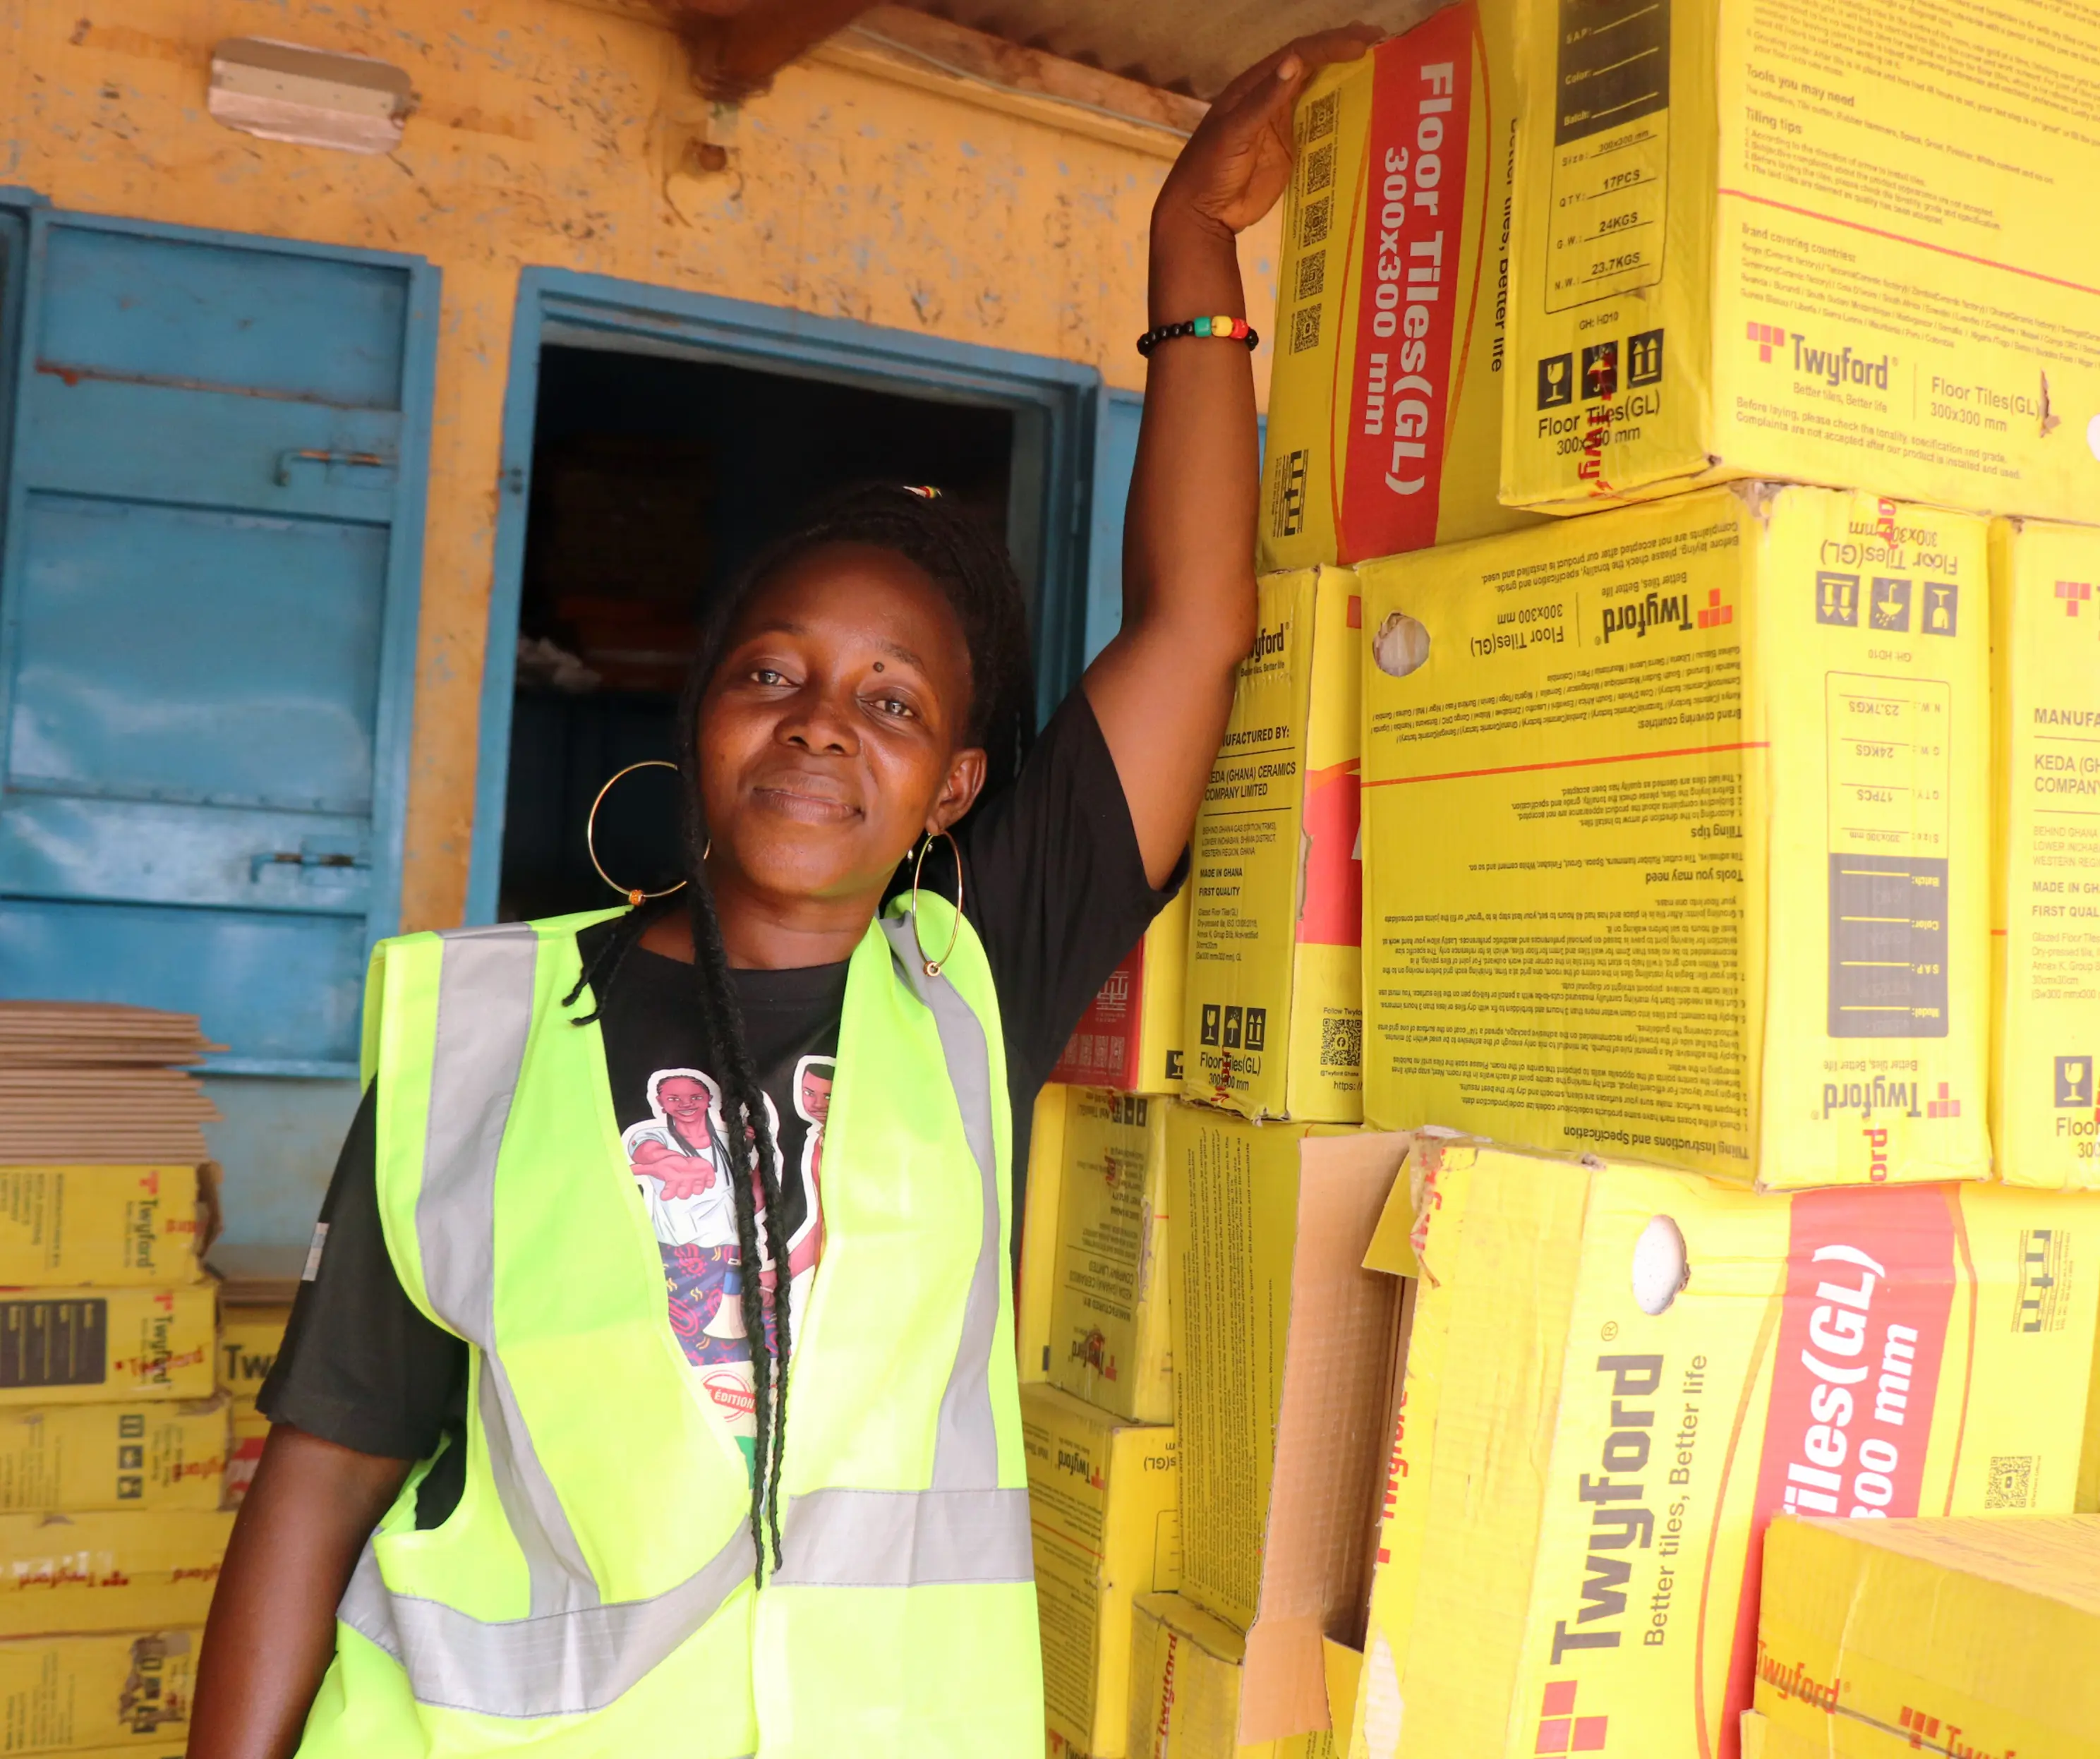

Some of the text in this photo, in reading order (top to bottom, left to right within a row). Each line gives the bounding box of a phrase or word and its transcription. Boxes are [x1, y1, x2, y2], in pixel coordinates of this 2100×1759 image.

[1564, 67, 1591, 86] Color:
[1745, 63, 1854, 107] Tools you may need
[1780, 116, 1802, 137] tips
[1603, 167, 1640, 192] 17PCS
[1598, 210, 1638, 234] 24KGS
[1591, 250, 1640, 276] 23.7KGS
[1385, 61, 1454, 495] Floor Tiles(GL)
[1364, 146, 1408, 436] 300x300 mm
[1579, 309, 1619, 331] GH: HD10
[1790, 332, 1888, 390] Twyford
[1793, 382, 1821, 397] Better
[1846, 393, 1871, 409] Better
[1874, 399, 1888, 413] life
[1931, 376, 2040, 421] Floor Tiles(GL)
[1538, 387, 1661, 439] Floor Tiles(GL)
[1931, 402, 2007, 432] 300x300 mm
[1614, 425, 1641, 445] mm
[1849, 521, 1878, 538] mm
[1481, 520, 1737, 586] Complaints are not accepted after our product is installed and used.
[1709, 536, 1739, 550] Before
[1625, 555, 1648, 567] check
[1651, 548, 1676, 562] please
[1819, 538, 1957, 576] Floor Tiles(GL)
[1580, 561, 1610, 576] tonality,
[1612, 559, 1624, 572] the
[1494, 581, 1516, 593] grade.
[1519, 578, 1531, 590] and
[1533, 569, 1579, 587] specification
[1601, 571, 1686, 599] Better tiles, Better life
[1497, 603, 1564, 625] 300x300 mm
[1603, 593, 1694, 643] Twyford
[1248, 623, 1284, 663] yford
[1470, 626, 1564, 658] Floor Tiles(GL)
[1867, 648, 1911, 663] GH: HD10
[1848, 699, 1899, 716] 23.7KGS
[1637, 708, 1741, 730] Brand covering countries:
[1276, 725, 1289, 739] BY:
[1855, 743, 1894, 758] 24KGS
[1209, 761, 1296, 785] EDA (GHANA) CERAMICS
[2034, 754, 2075, 773] KEDA
[1205, 783, 1267, 801] COMPANY LIMITED
[1856, 788, 1893, 803] 17PCS
[1690, 821, 1742, 840] Tiling tips
[1849, 831, 1864, 841] mm
[1866, 831, 1900, 843] 300x300
[1200, 867, 1243, 878] MADE IN GHANA
[1645, 866, 1743, 885] Tools you may need
[1199, 887, 1240, 896] FIRST QUALITY
[2032, 881, 2065, 893] MADE
[2068, 882, 2080, 894] IN
[2032, 905, 2065, 917] FIRST
[1910, 918, 1939, 931] Color:
[1200, 1052, 1222, 1069] Floor
[1823, 1057, 1917, 1072] Better tiles, Better life
[1236, 1080, 1249, 1092] mm
[1823, 1074, 1921, 1118] Twyford
[1563, 1123, 1629, 1144] Specification
[2056, 1117, 2100, 1137] Floor
[1631, 1132, 1651, 1147] and
[1653, 1135, 1715, 1155] Instructions
[134, 1199, 158, 1268] Twyford
[1874, 1323, 1919, 1426] mm
[715, 1388, 755, 1409] ÉDITION
[1058, 1449, 1090, 1484] Twyford
[1550, 1354, 1664, 1665] Twyford
[1643, 1354, 1708, 1646] Better tiles, Better life
